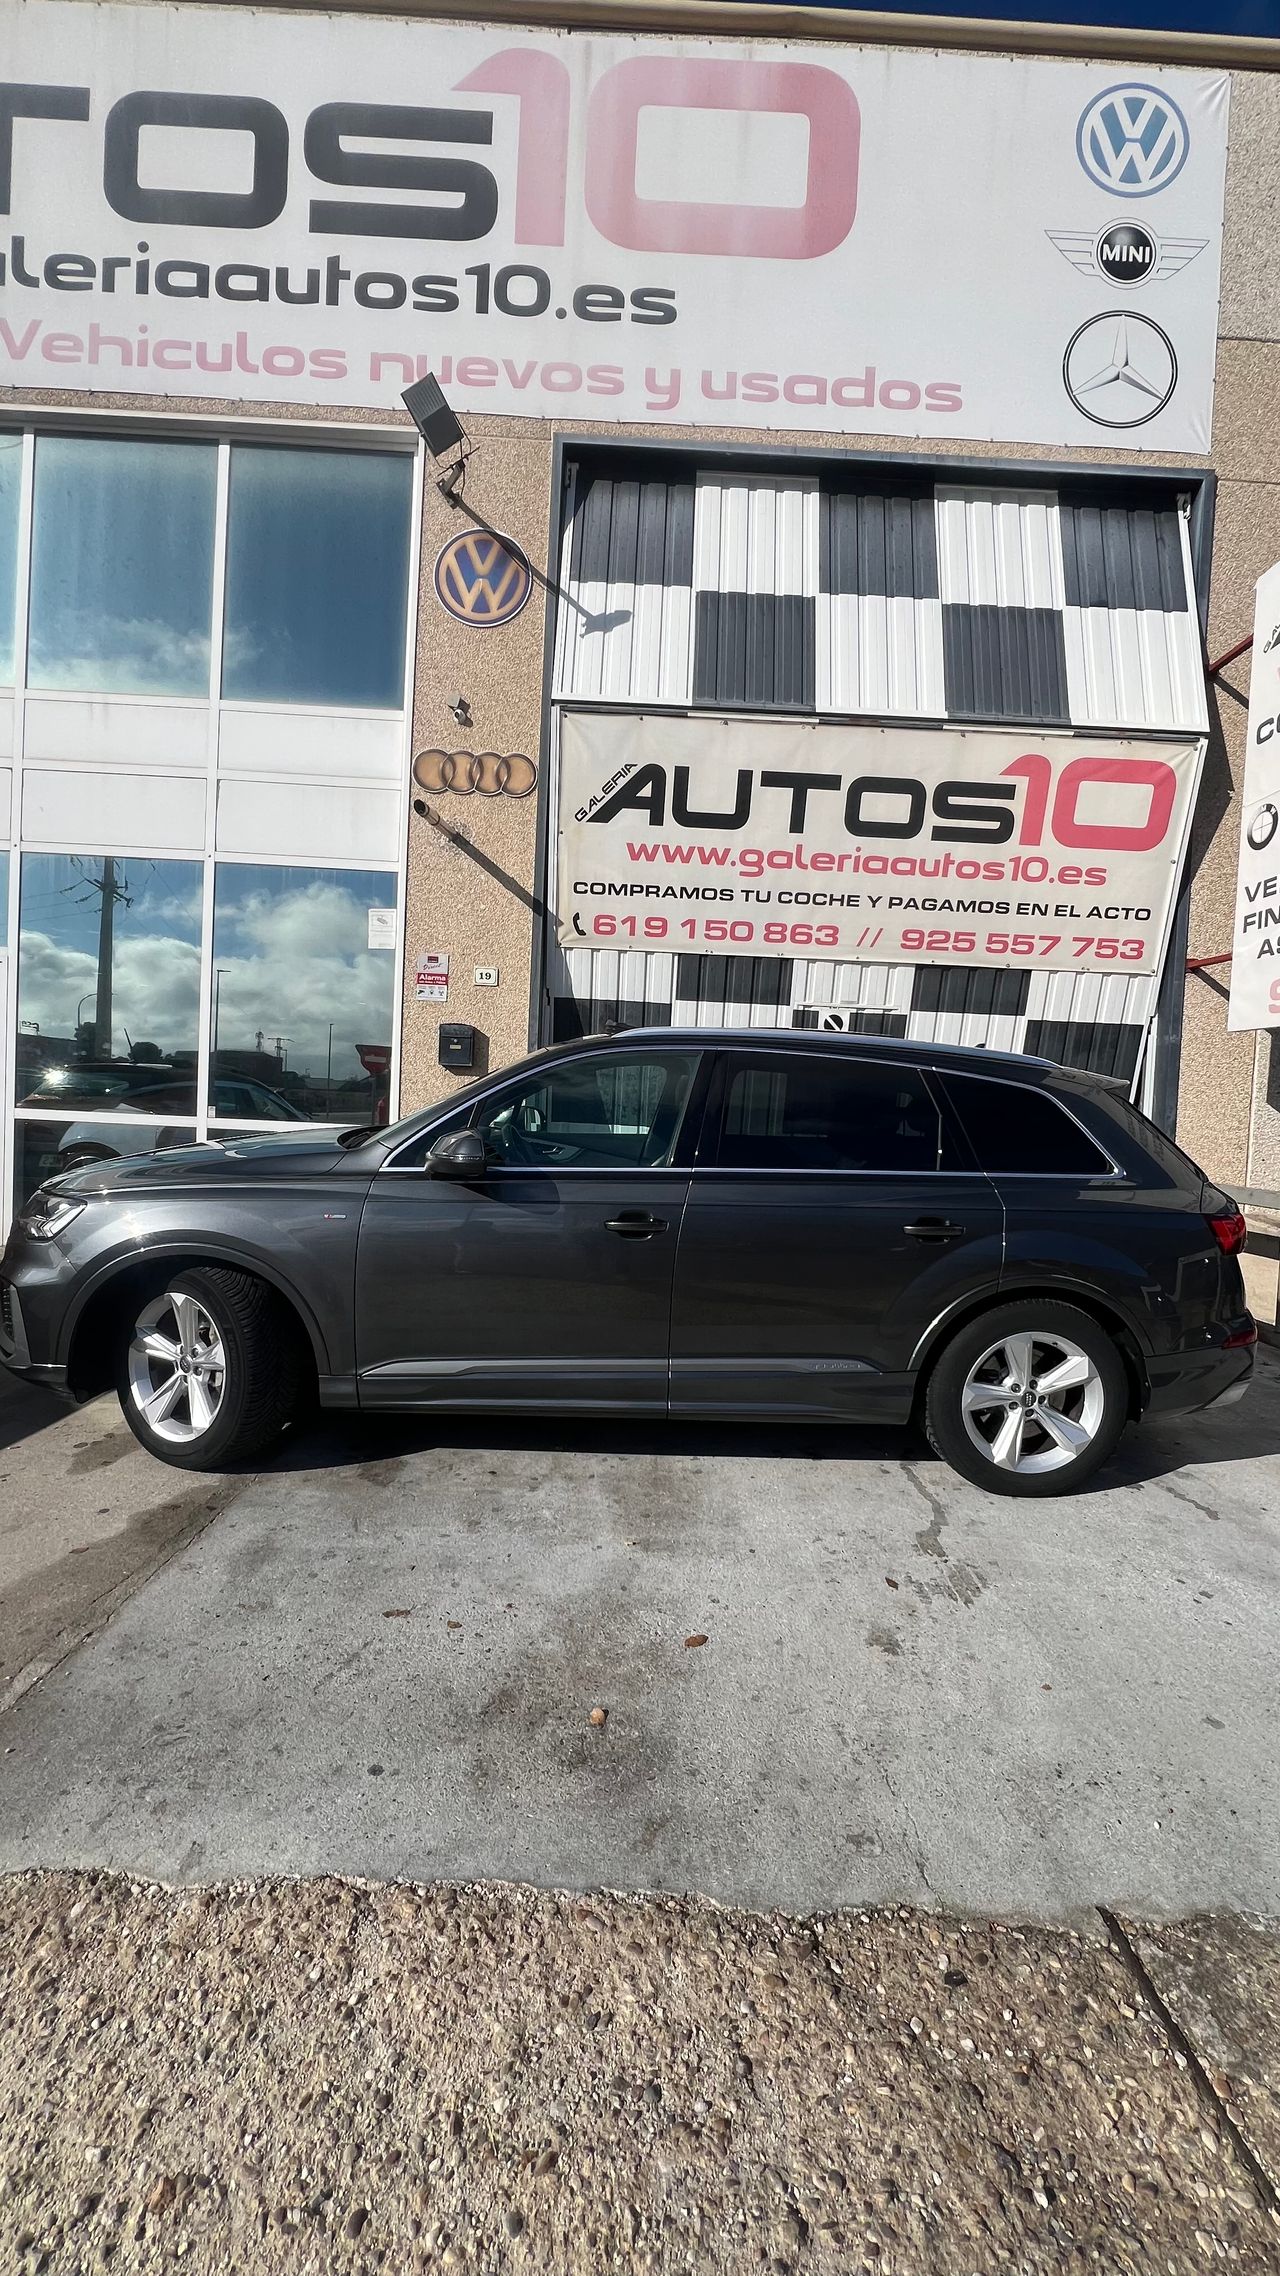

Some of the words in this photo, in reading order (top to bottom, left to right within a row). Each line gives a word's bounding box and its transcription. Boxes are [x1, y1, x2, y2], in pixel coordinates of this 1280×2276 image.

[1102, 243, 1151, 263] MINI
[0, 235, 678, 325] leriaautos10.es
[0, 318, 348, 381] Vehiculos
[369, 353, 625, 396] nuevos
[644, 367, 683, 412] y
[700, 367, 964, 415] usados
[574, 763, 638, 822] GALERIA
[585, 753, 1178, 852] AUTOS10
[626, 842, 1107, 887] www.galeriaautos10.es
[573, 881, 734, 902] COMPRAMOS
[740, 889, 772, 902] TU
[778, 892, 861, 908] COCHE
[867, 895, 883, 908] Y
[889, 897, 1010, 914] PAGAMOS
[1016, 903, 1049, 916] EN
[1054, 904, 1081, 917] EL
[1085, 905, 1152, 920] ACTO
[593, 914, 669, 938] 619
[681, 918, 754, 942] 150
[764, 922, 839, 946] 863
[901, 929, 976, 953] 925
[986, 932, 1062, 956] 557
[1072, 936, 1145, 960] 753
[479, 972, 492, 980] 19
